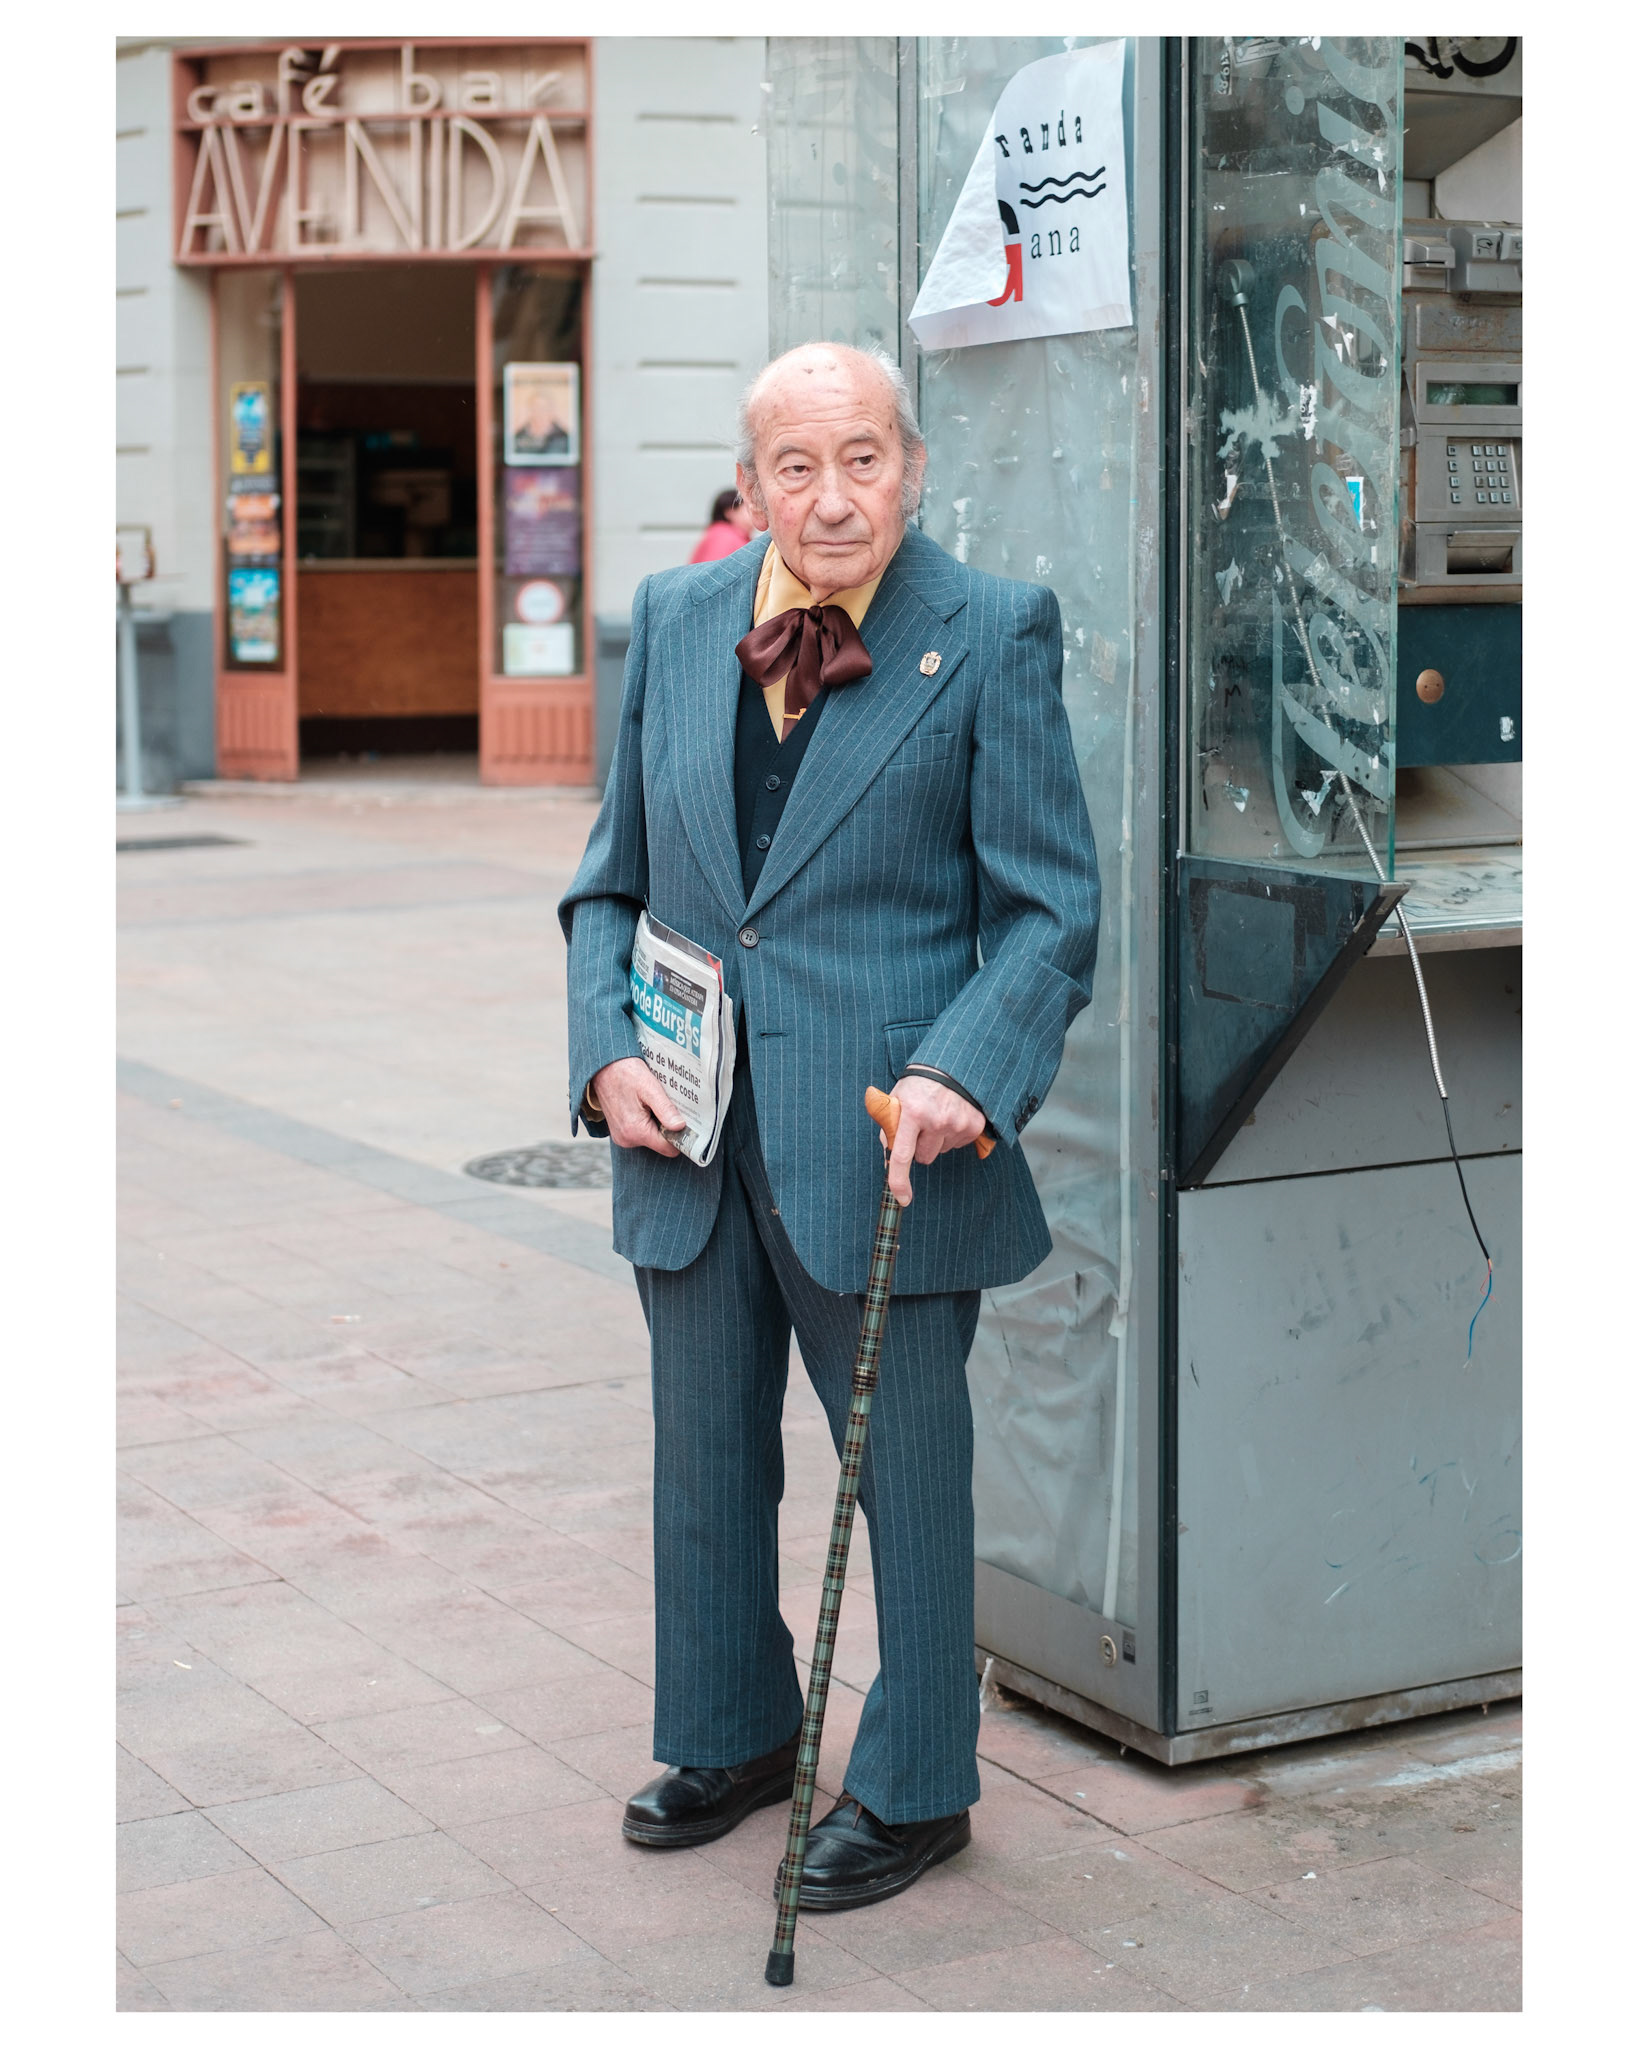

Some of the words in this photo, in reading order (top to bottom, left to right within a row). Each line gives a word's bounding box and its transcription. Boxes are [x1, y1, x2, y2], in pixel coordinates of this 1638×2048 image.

[188, 42, 343, 123] café
[402, 42, 563, 114] bar
[180, 114, 583, 260] AVENIDA
[680, 1084, 699, 1105] coste
